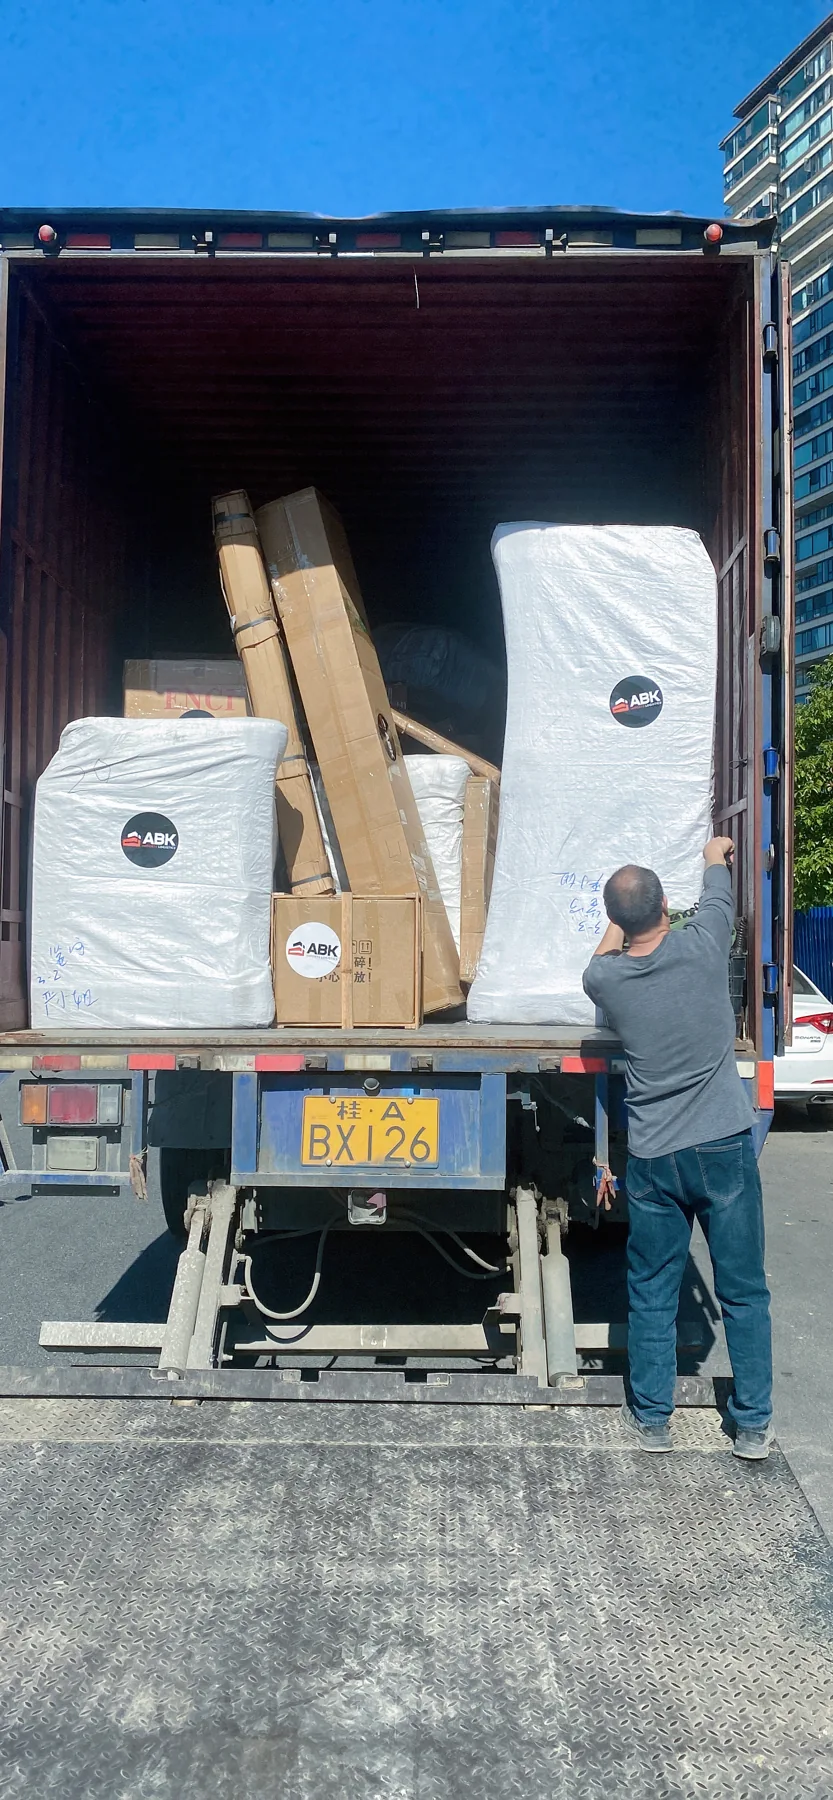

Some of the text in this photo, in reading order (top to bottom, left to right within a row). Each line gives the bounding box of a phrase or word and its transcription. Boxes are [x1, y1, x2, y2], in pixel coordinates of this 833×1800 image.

[630, 689, 661, 708] ABK
[142, 831, 177, 846] ABK
[306, 943, 339, 957] ABK
[309, 1124, 431, 1162] BX126
